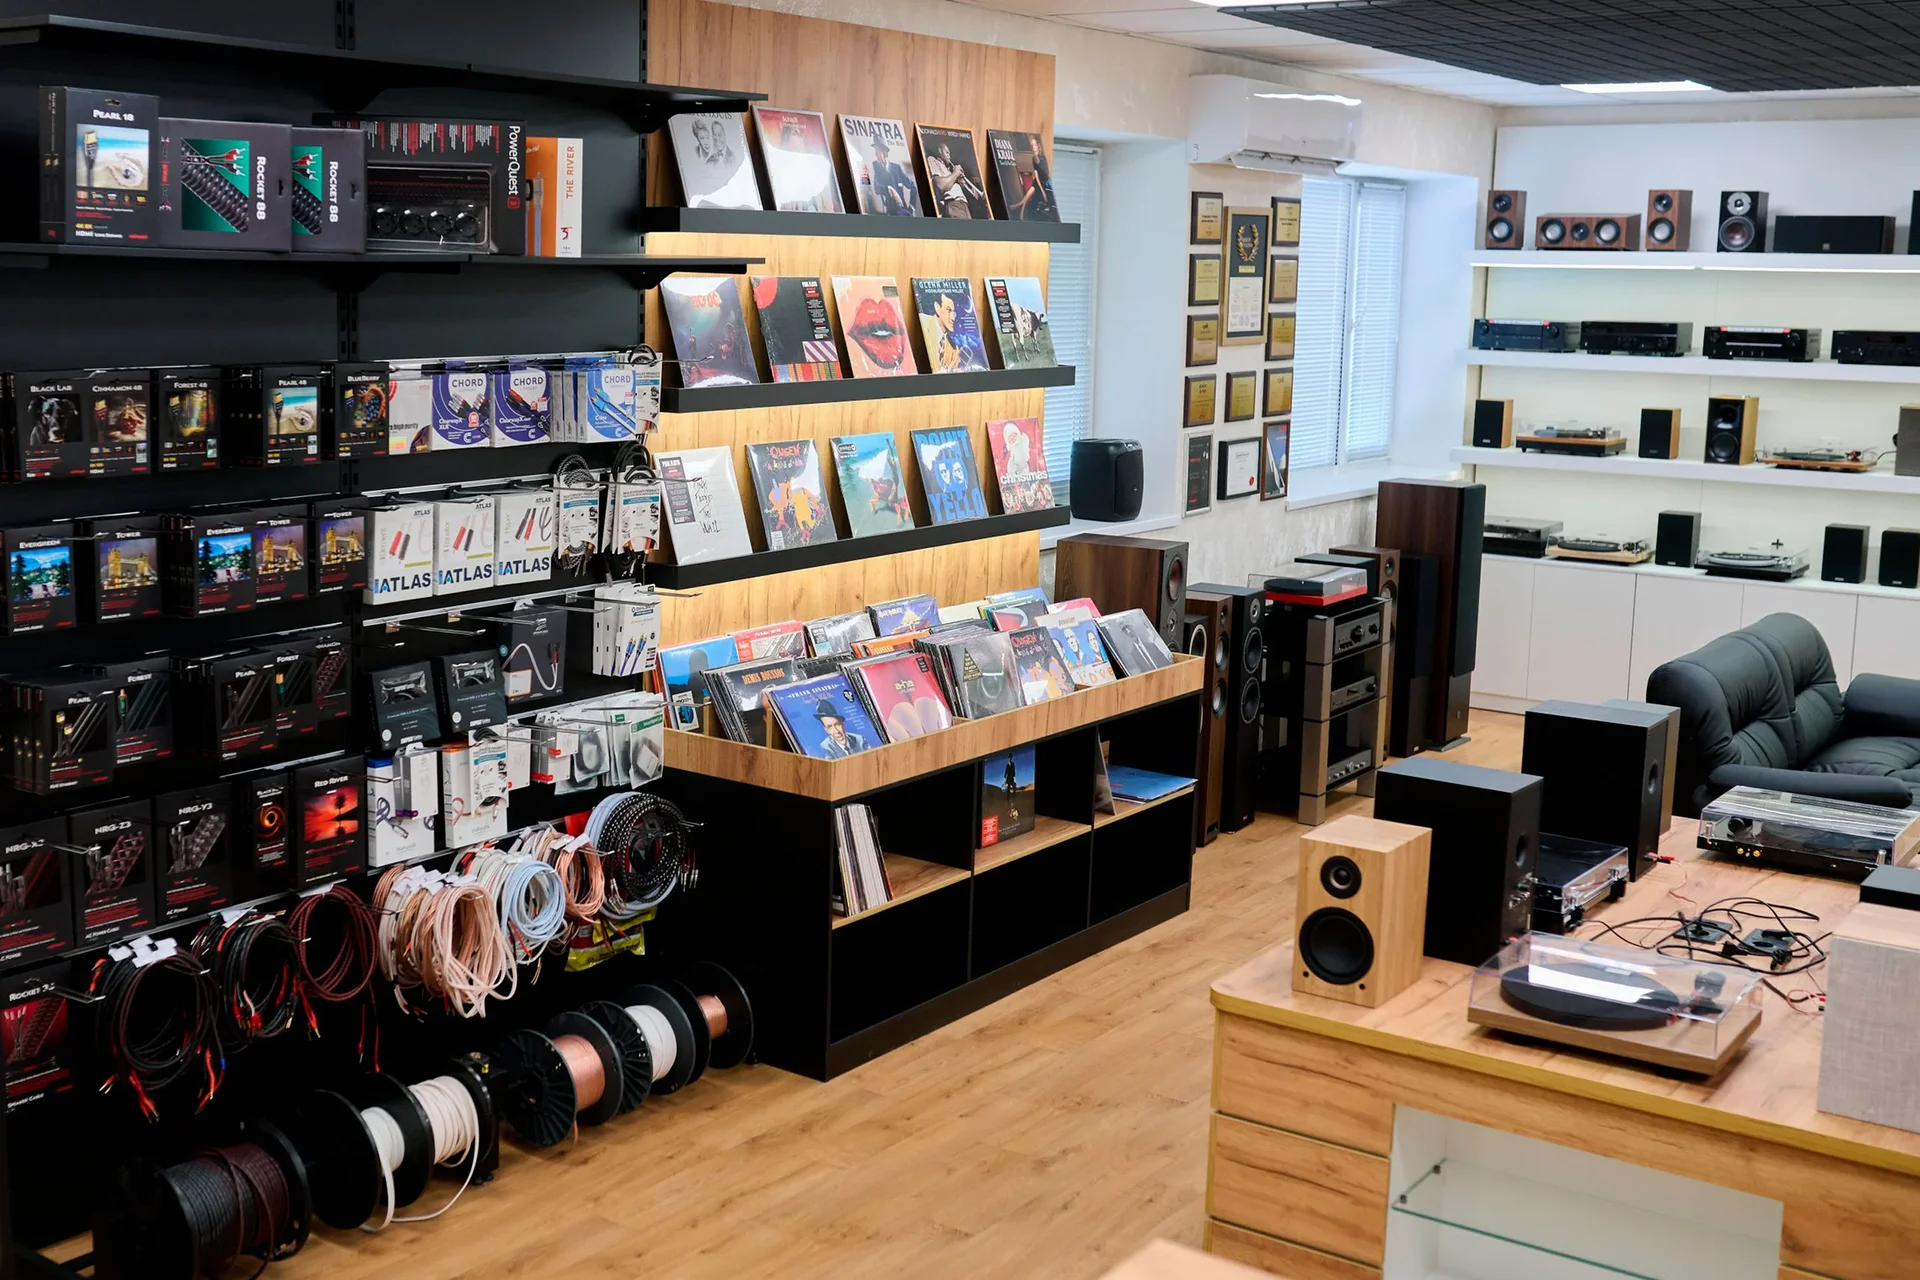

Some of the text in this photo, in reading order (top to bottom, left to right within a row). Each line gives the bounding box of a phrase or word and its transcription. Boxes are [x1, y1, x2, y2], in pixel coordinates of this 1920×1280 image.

[93, 109, 134, 122] PEARL 18
[844, 117, 904, 141] SINATRA
[994, 138, 1013, 150] DIANA
[507, 125, 521, 196] PowerQuest
[996, 148, 1016, 161] KRALL
[566, 146, 575, 199] THE RIVER
[256, 156, 266, 221] ROCKET 88
[329, 161, 338, 223] ROCKET 88
[918, 281, 967, 289] GLENN MILLER
[452, 378, 484, 388] CHORD
[513, 376, 544, 386] CHORD
[604, 375, 631, 384] CHORD
[30, 384, 73, 393] BLACK LAB
[92, 385, 132, 393] CINNAMON
[769, 445, 800, 460] QUEEN
[999, 469, 1049, 486] christmas
[475, 502, 492, 510] ATLAS
[928, 488, 986, 522] YELLO
[413, 509, 431, 517] ATLAS
[269, 519, 291, 527] TOWER
[115, 531, 141, 539] TOWER
[206, 526, 244, 536] EVERGREEN
[19, 539, 61, 549] EVERGREEN
[1011, 634, 1037, 648] QUEEN
[276, 655, 299, 663] FOREST
[127, 673, 152, 683] FOREST
[235, 670, 256, 678] PEARL
[741, 667, 785, 685] DEMIS ROUSSOS
[790, 684, 836, 699] FRANK SINATRA
[68, 696, 92, 705] PEARL
[314, 775, 349, 788] RED RIVER
[178, 802, 213, 816] NRG-Y3
[95, 821, 133, 835] NRG-Z3
[9, 987, 41, 1002] ROCKET
[7, 1092, 45, 1108] SPEAKER CABLE
